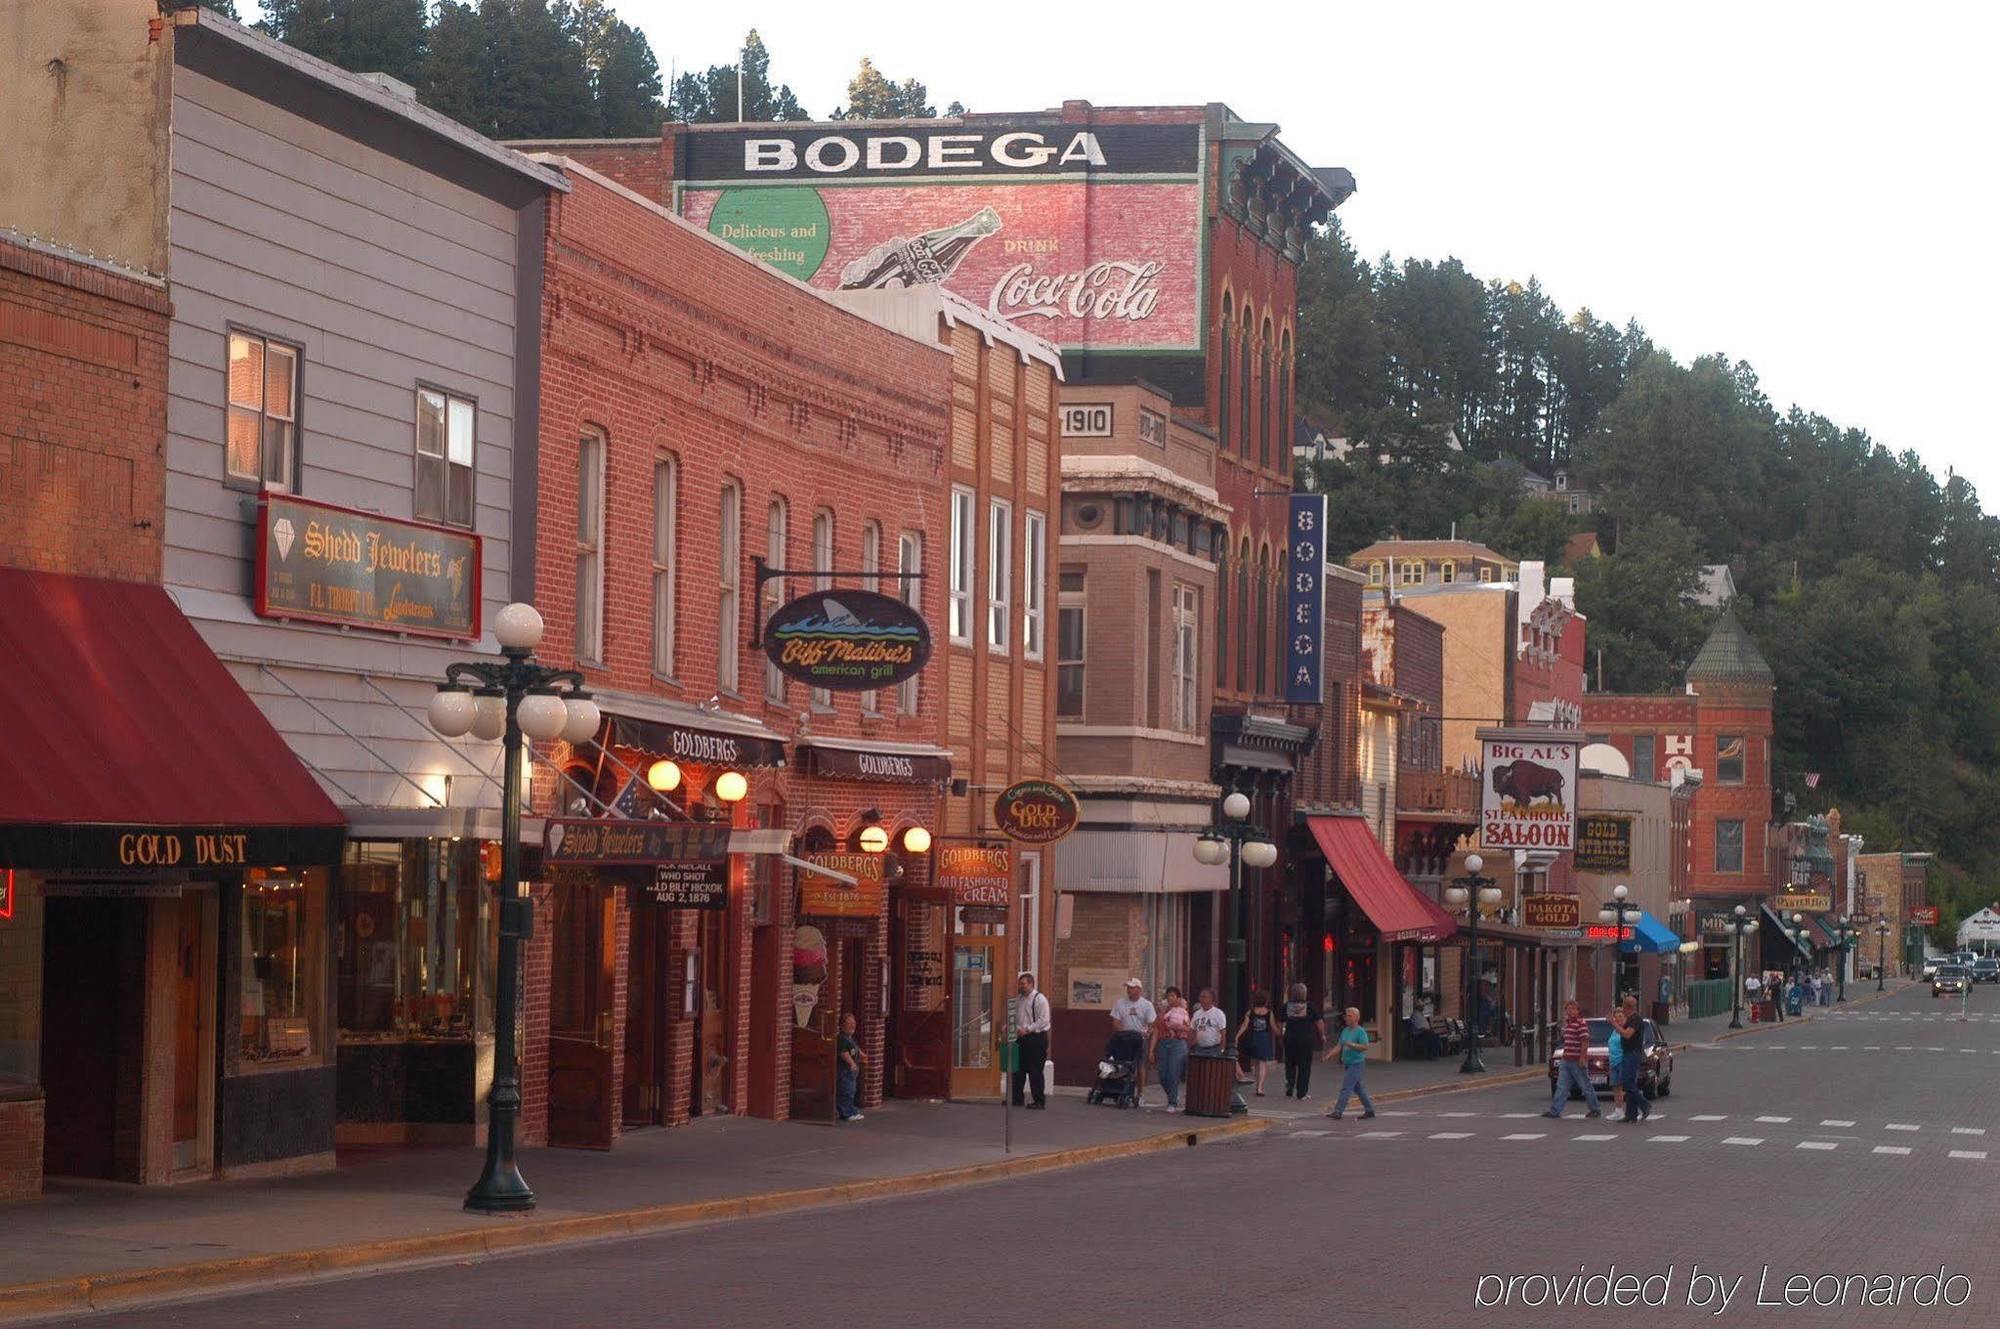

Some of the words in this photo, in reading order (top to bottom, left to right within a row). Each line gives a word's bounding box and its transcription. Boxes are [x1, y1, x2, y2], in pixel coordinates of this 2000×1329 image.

[745, 132, 1107, 172] BODEGA
[722, 223, 786, 239] Delicious
[790, 222, 817, 238] and
[1003, 239, 1059, 252] DRINK
[748, 246, 805, 265] freshing
[1065, 409, 1107, 432] 1910
[304, 520, 361, 567] Shedd
[365, 531, 442, 579] Jewelers
[1294, 511, 1315, 686] BODEGA
[825, 639, 913, 664] Malibu's
[810, 663, 866, 676] american
[871, 662, 894, 679] grill
[673, 730, 738, 762] GOLDBERGS
[1492, 744, 1524, 758] BIG
[1530, 746, 1570, 760] AL'S
[858, 753, 914, 777] GOLDBERGS
[1010, 800, 1057, 817] GOLD
[1484, 809, 1573, 822] STEAKHOUSE
[1020, 815, 1060, 829] DUST
[1587, 821, 1618, 837] GOLD
[1485, 823, 1570, 847] SALOON
[119, 833, 182, 865] GOLD
[195, 834, 248, 864] DUST
[805, 855, 880, 882] GOLDBERGS
[940, 849, 1009, 872] GOLDBERGS
[660, 871, 682, 881] WHO
[683, 872, 707, 881] SHOT
[958, 876, 1009, 891] FASHIONED
[656, 892, 676, 902] AUG
[963, 887, 1009, 903] CREAM
[1528, 904, 1578, 914] DAKOTA
[1536, 913, 1570, 923] GOLD
